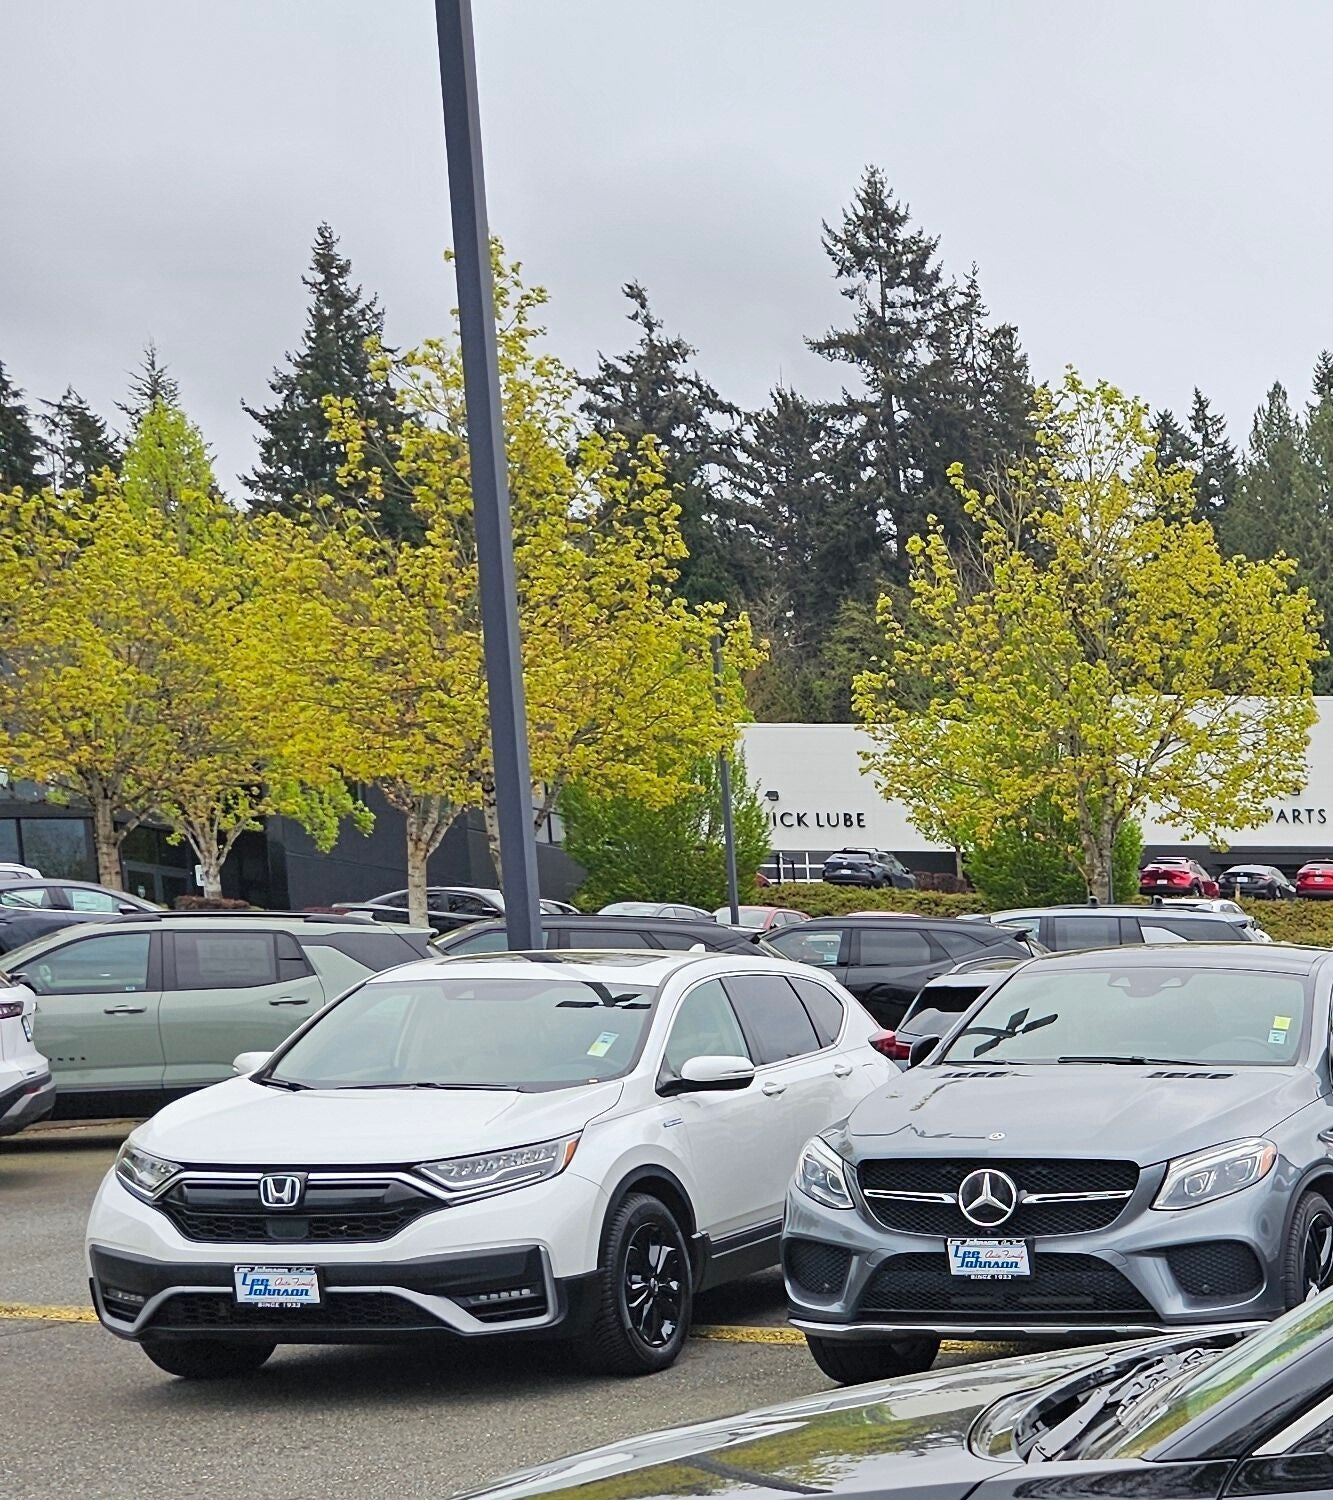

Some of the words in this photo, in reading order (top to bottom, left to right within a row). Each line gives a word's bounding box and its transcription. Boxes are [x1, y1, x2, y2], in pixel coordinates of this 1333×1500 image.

[815, 812, 867, 828] LUBE
[953, 1245, 982, 1259] Lee
[956, 1257, 1021, 1269] Johnson
[241, 1272, 270, 1286] Lee
[244, 1283, 311, 1297] Johnson
